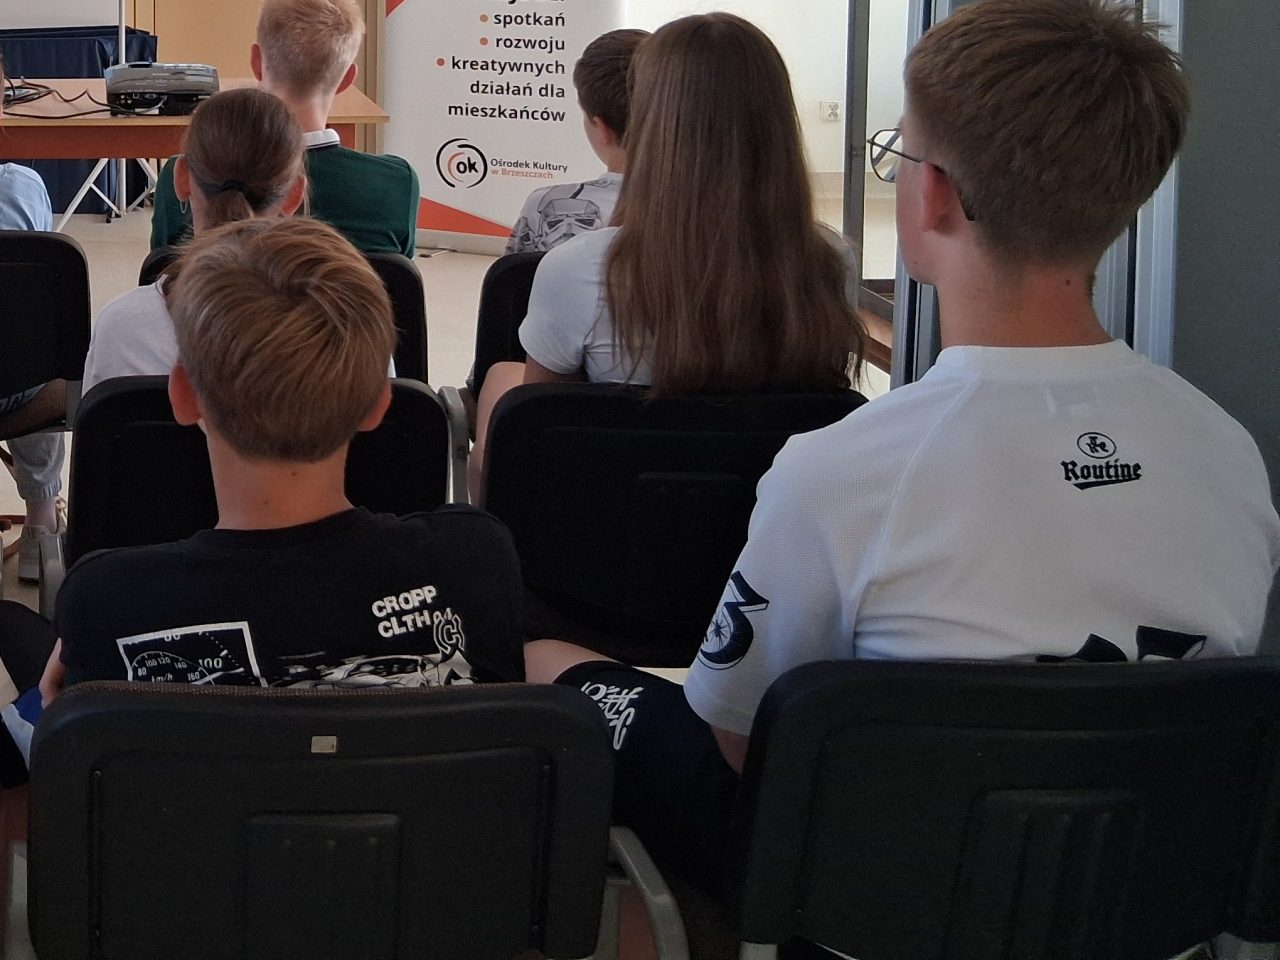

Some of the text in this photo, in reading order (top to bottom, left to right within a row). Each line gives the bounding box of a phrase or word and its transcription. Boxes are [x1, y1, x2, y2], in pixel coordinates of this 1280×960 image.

[493, 11, 566, 28] spotkań
[495, 37, 566, 53] rozwoju
[451, 56, 566, 76] kreatywnych
[470, 80, 566, 98] działań dla
[448, 103, 566, 122] mieszkańców
[456, 156, 478, 174] ok
[490, 158, 568, 173] Ośrodek Kultury
[501, 168, 553, 179] Brzeszczach
[1060, 458, 1142, 481] Routine
[371, 585, 437, 618] CROPP
[174, 661, 188, 669] 140
